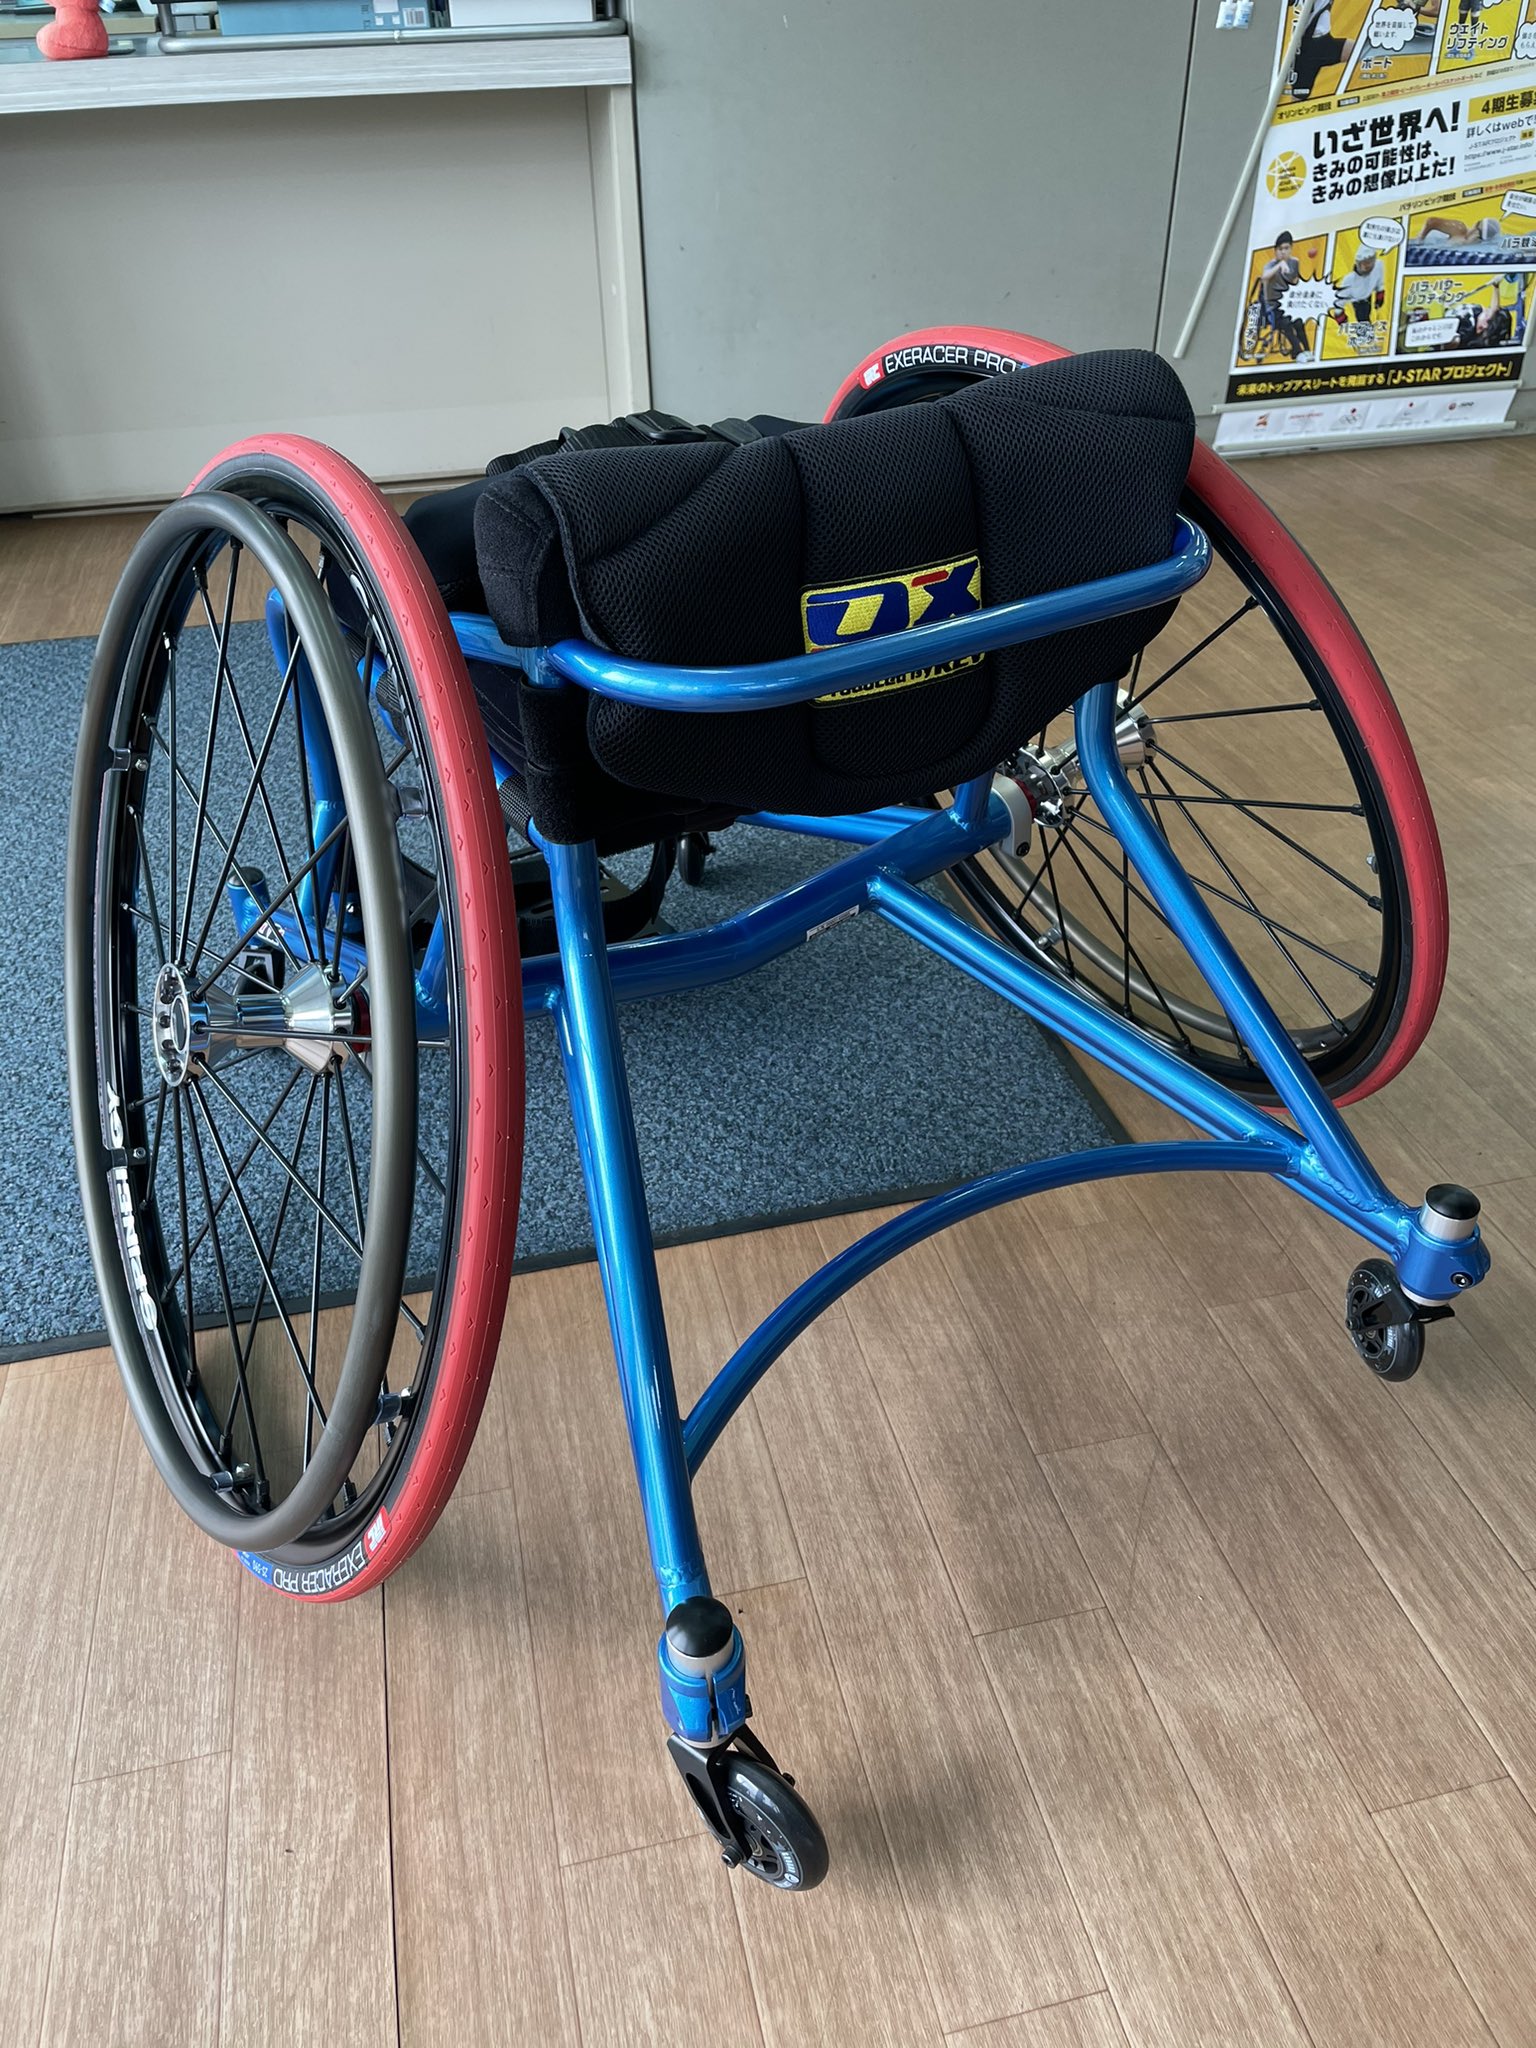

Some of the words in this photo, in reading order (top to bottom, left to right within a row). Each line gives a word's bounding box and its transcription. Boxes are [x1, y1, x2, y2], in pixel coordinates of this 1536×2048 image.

[1446, 36, 1508, 50] リフティング
[1360, 57, 1392, 70] ボート
[1481, 90, 1536, 114] 4期生募
[1313, 101, 1461, 160] いざ世界へ!
[1466, 113, 1536, 139] 詳しくはwebで
[1312, 140, 1440, 183] きみの可能性は、
[1311, 156, 1456, 205] きみの想像以上だ!
[884, 345, 968, 374] EXERACER
[973, 349, 1017, 374] PRO
[302, 1540, 366, 1593] EXERACER
[273, 1568, 300, 1593] PRO
